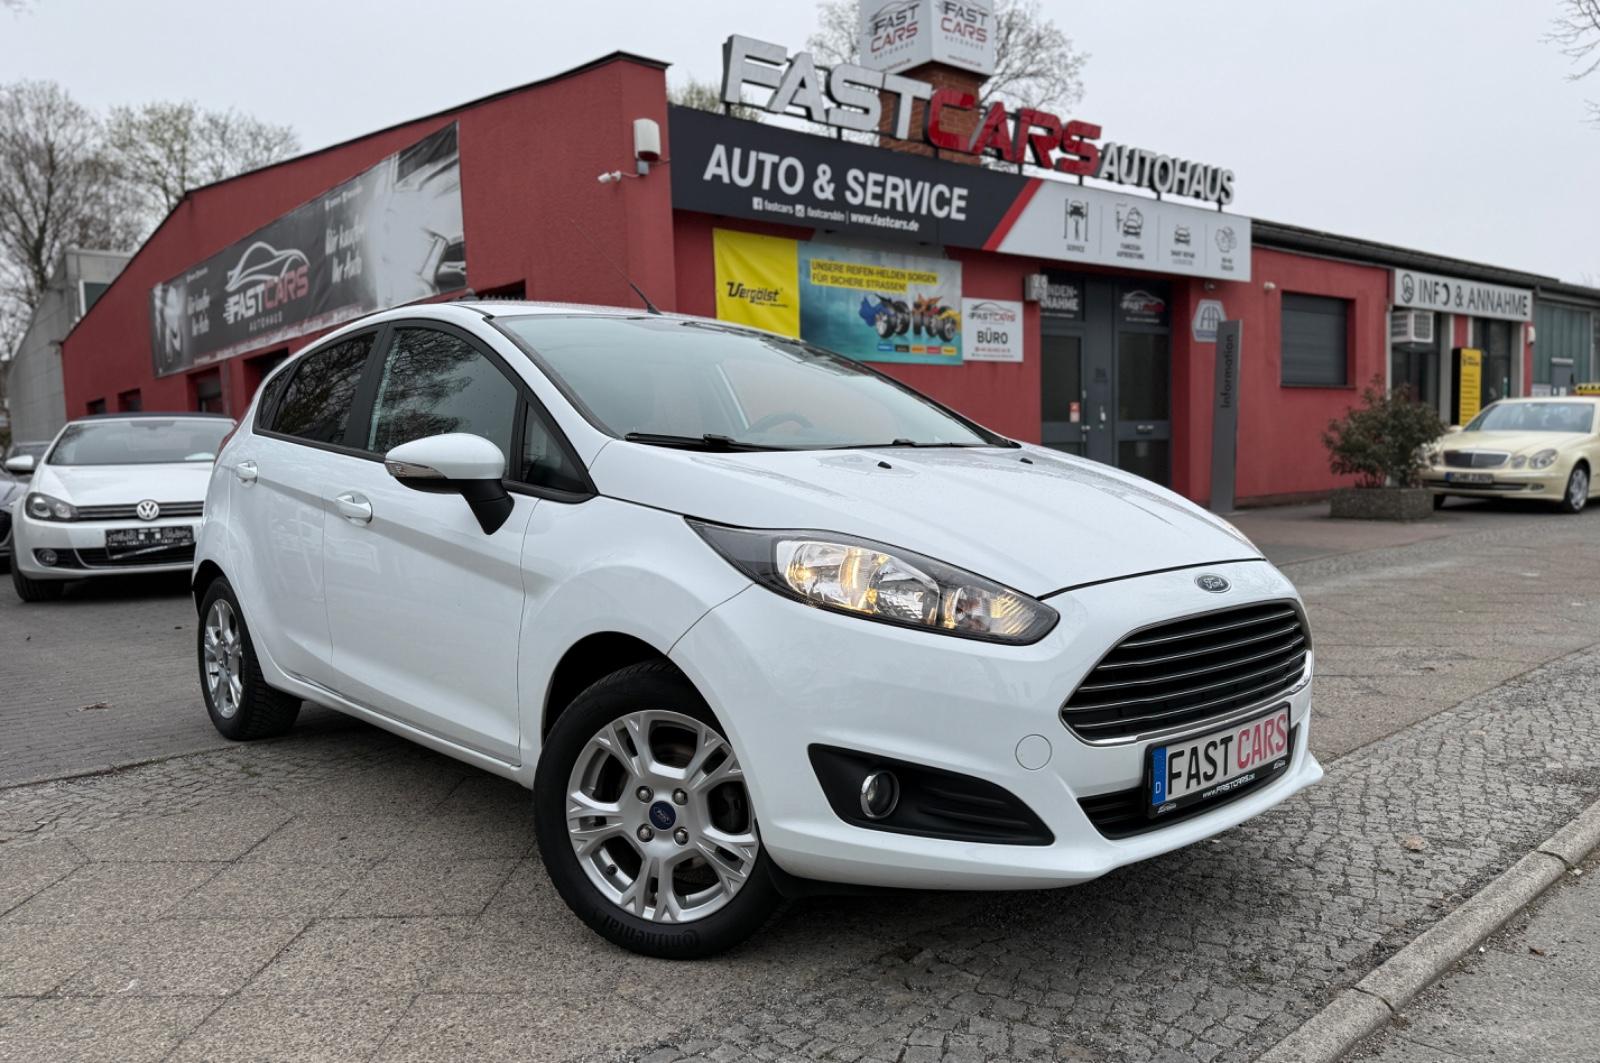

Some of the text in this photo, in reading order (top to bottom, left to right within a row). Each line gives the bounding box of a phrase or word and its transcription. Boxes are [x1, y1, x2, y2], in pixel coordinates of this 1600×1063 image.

[872, 3, 919, 35] FAST
[943, 1, 988, 25] FAST
[871, 21, 918, 53] CARS
[941, 16, 987, 43] CARS
[703, 144, 968, 221] AUTO & SERVICE
[1099, 142, 1236, 205] AUTOHAUS
[850, 212, 920, 232] www.fastcars.de
[812, 261, 844, 273] UNSERE
[907, 271, 937, 284] SORGEN
[812, 271, 829, 282] FÜR
[726, 281, 780, 304] Vergölst
[1455, 285, 1463, 307] &
[1467, 287, 1528, 317] ANNAHME
[249, 310, 282, 332] AUTOHAUS
[977, 327, 1009, 344] BÜRO
[1220, 334, 1234, 409] Information
[1168, 713, 1287, 795] FAST CARS
[1155, 781, 1161, 794] D
